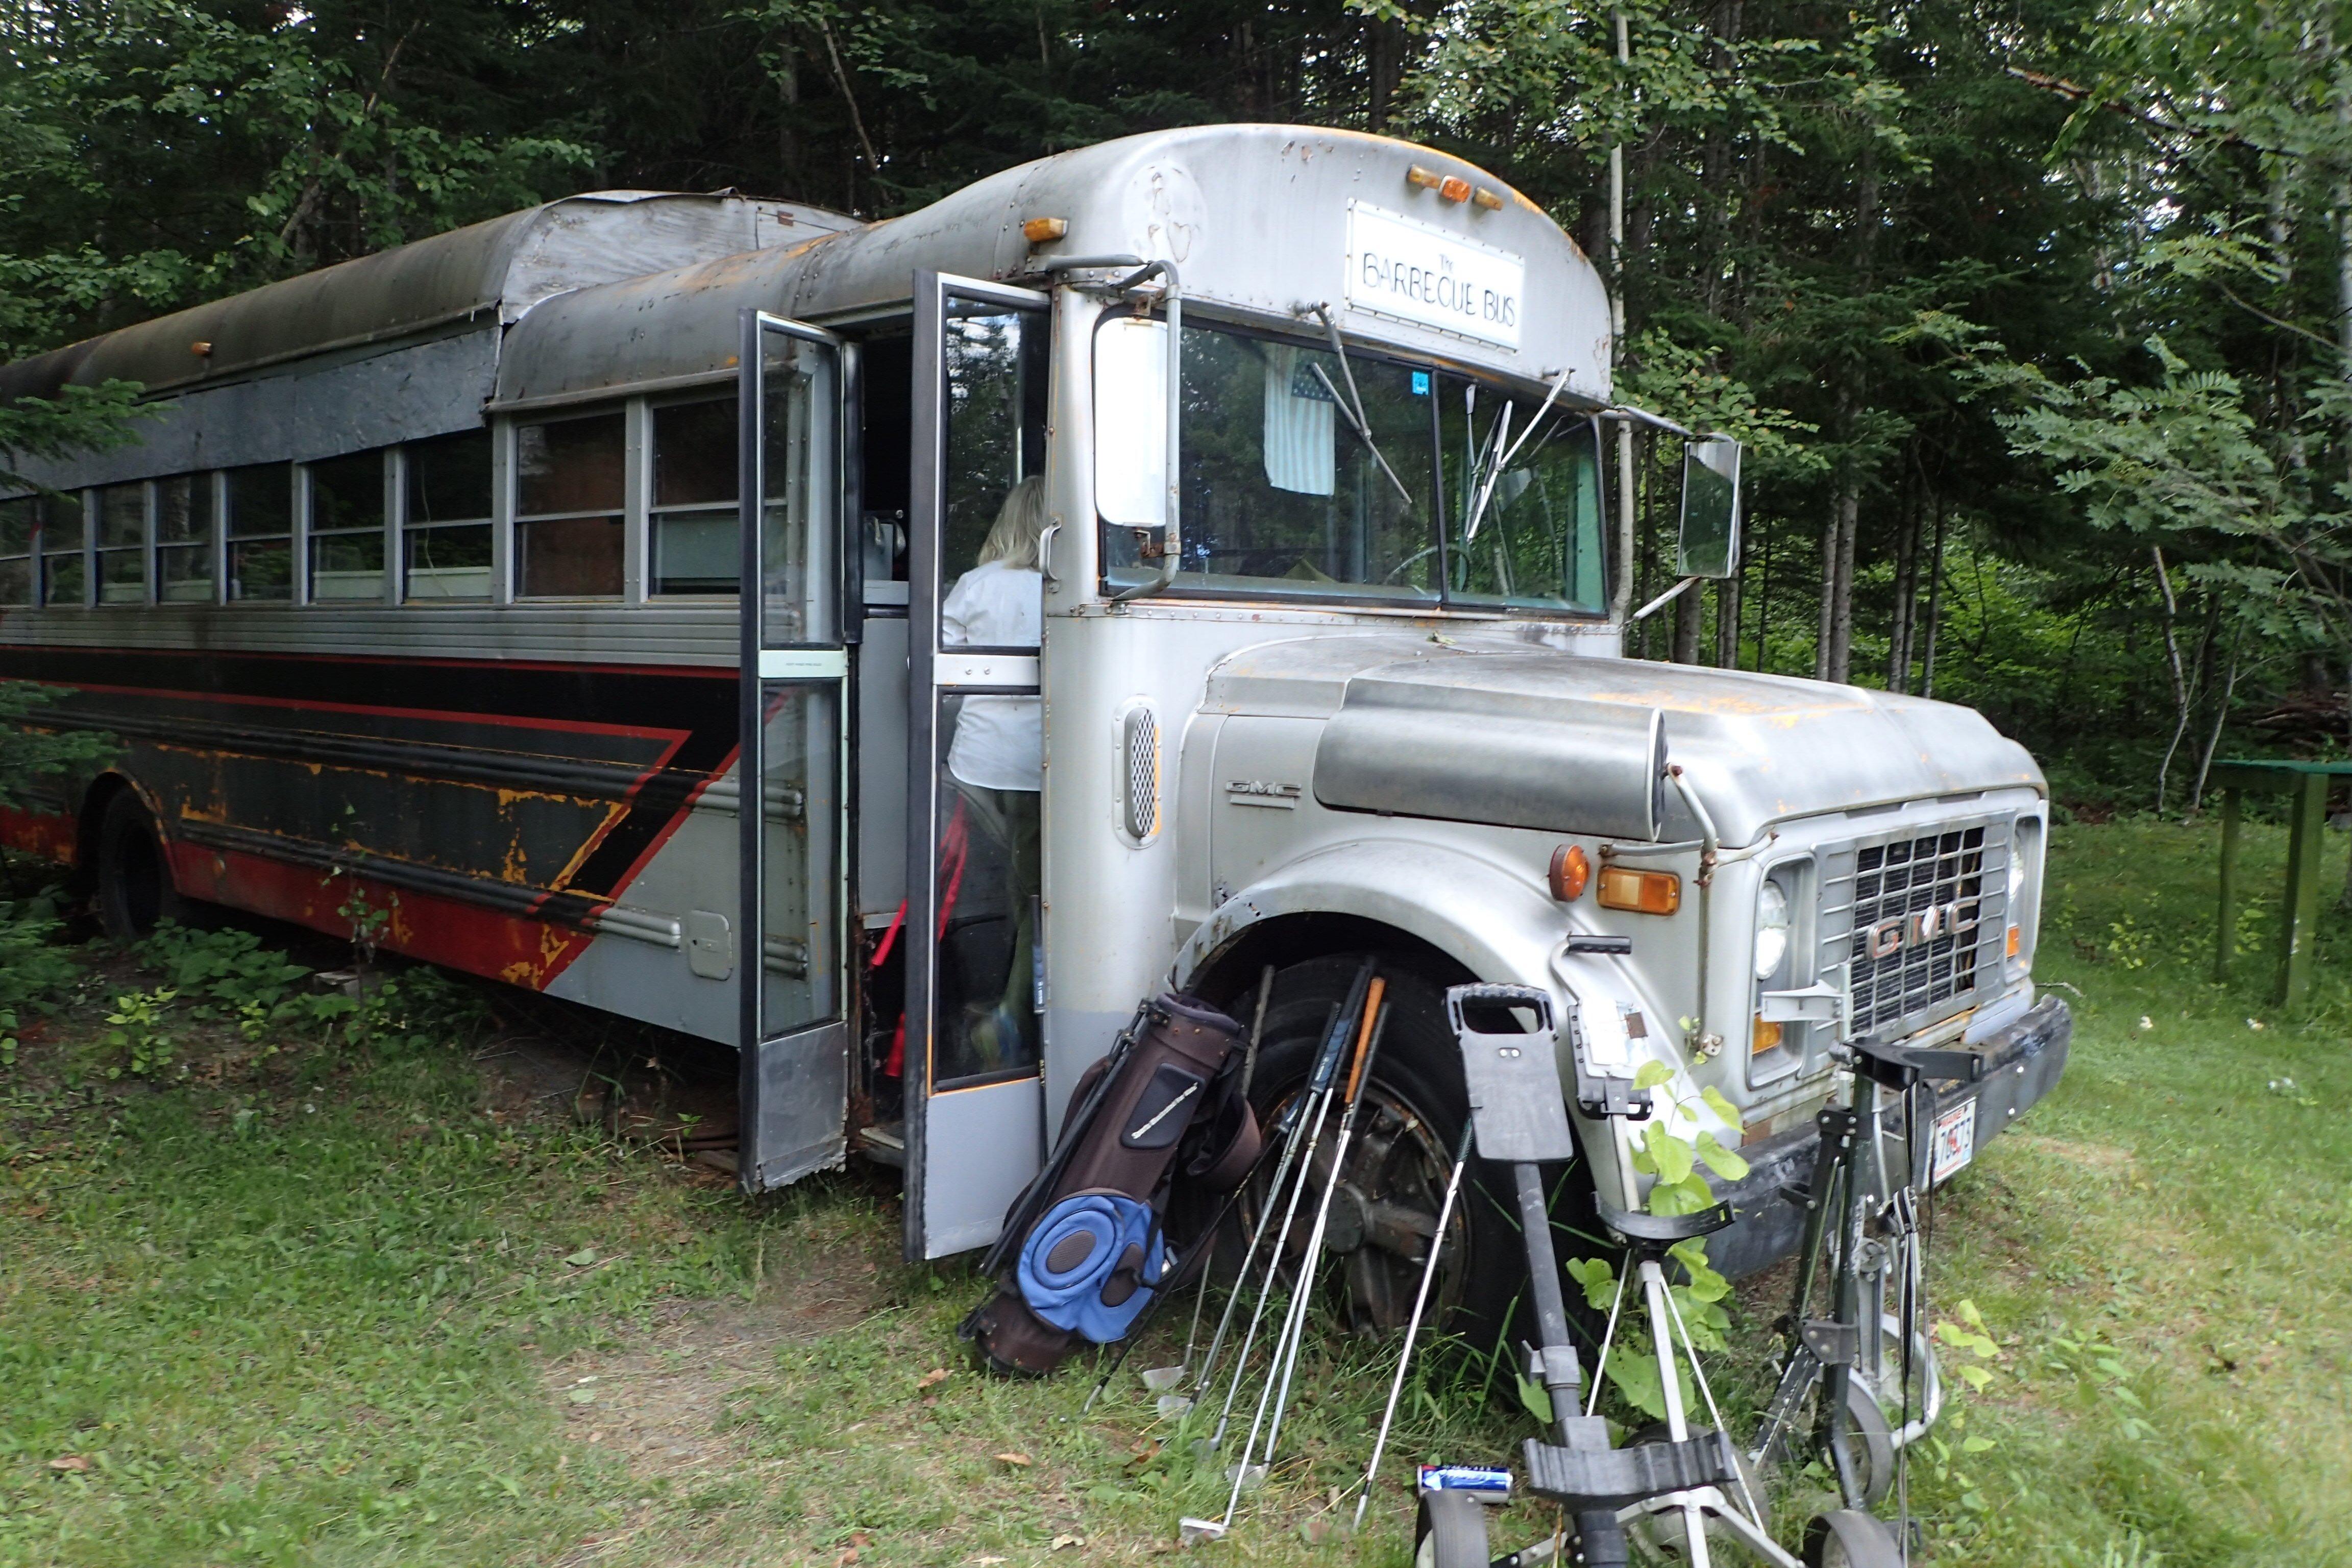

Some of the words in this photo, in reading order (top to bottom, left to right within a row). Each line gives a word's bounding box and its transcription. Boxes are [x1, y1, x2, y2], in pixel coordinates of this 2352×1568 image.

[1363, 253, 1476, 315] BARBECUE
[1485, 289, 1514, 327] BUS
[1226, 780, 1302, 797] GMC
[1866, 899, 1977, 960] GMC
